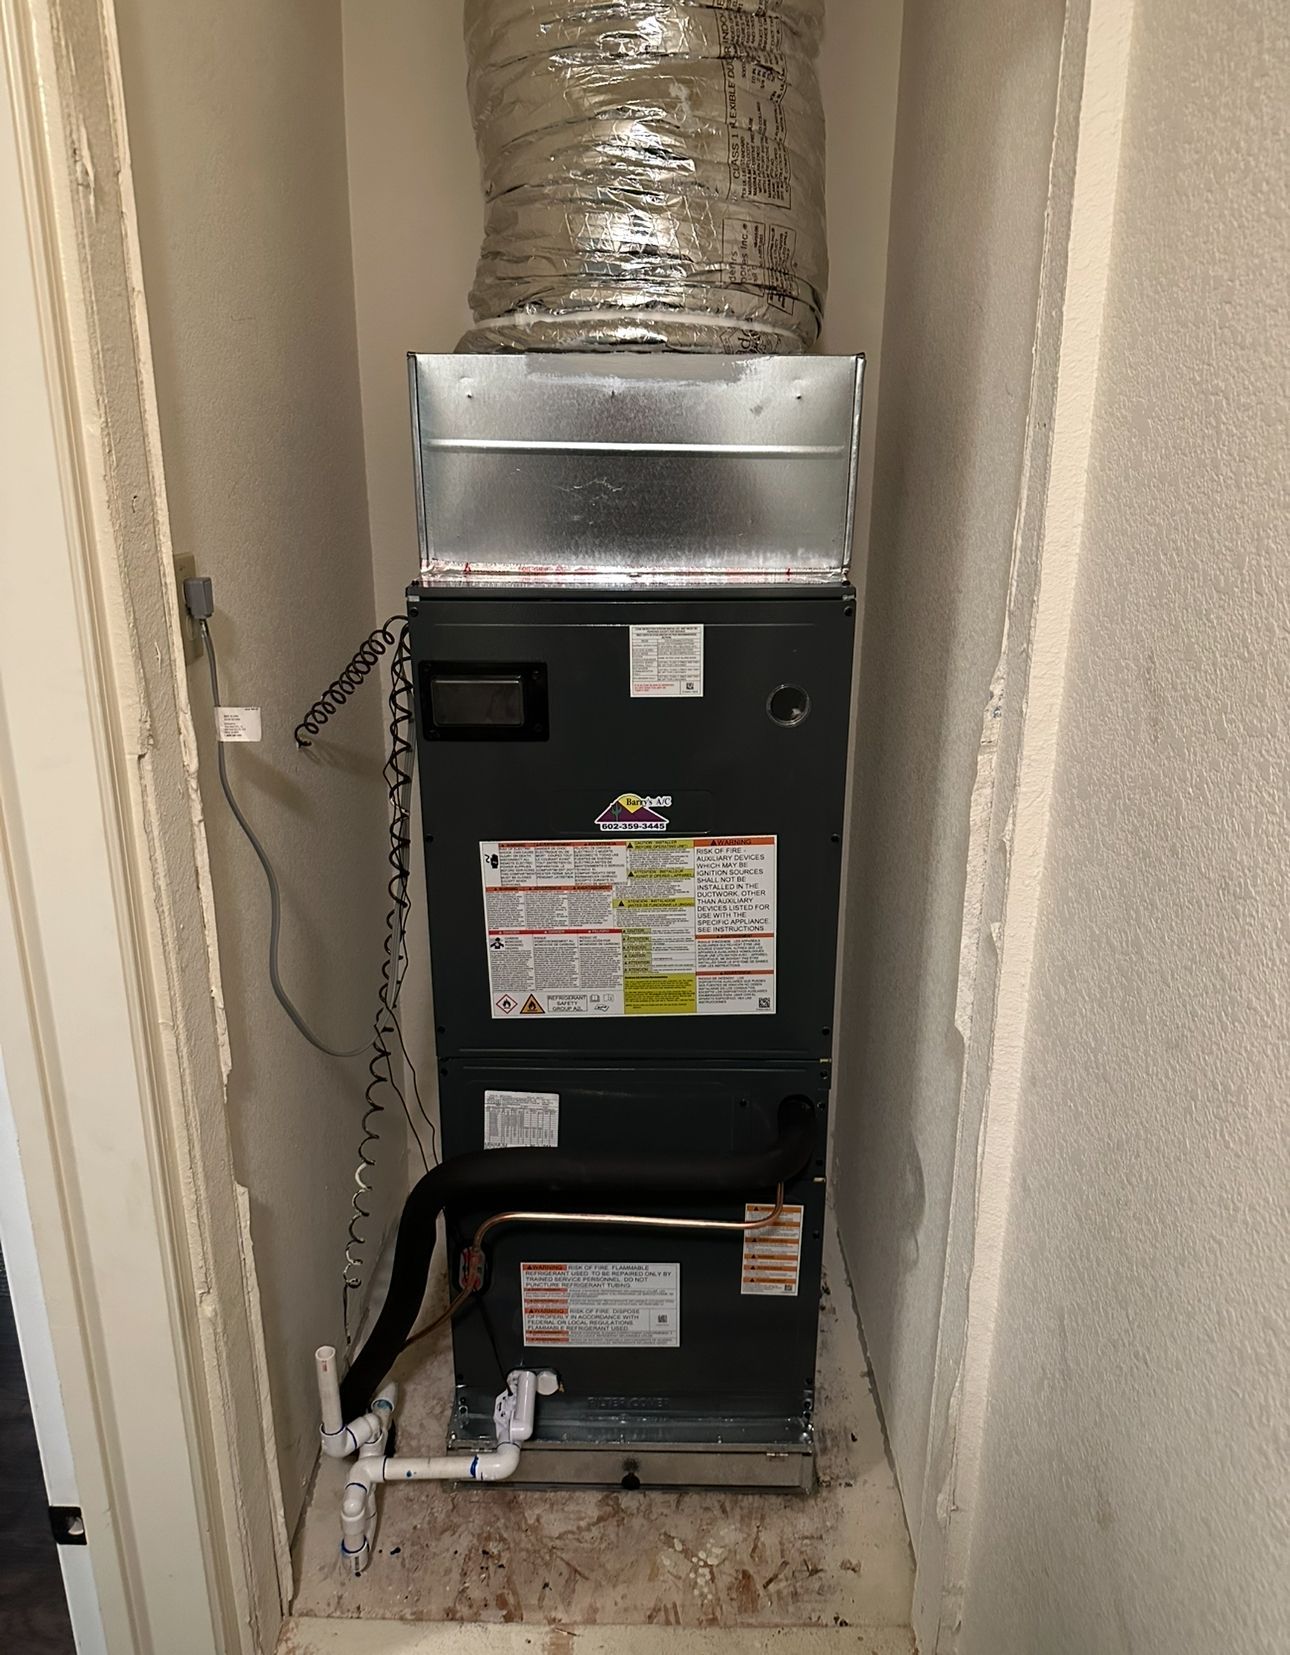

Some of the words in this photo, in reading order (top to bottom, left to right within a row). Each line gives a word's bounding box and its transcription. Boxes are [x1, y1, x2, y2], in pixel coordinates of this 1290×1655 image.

[731, 142, 741, 179] CLASS
[626, 797, 653, 807] Barry's
[655, 797, 671, 805] A/C
